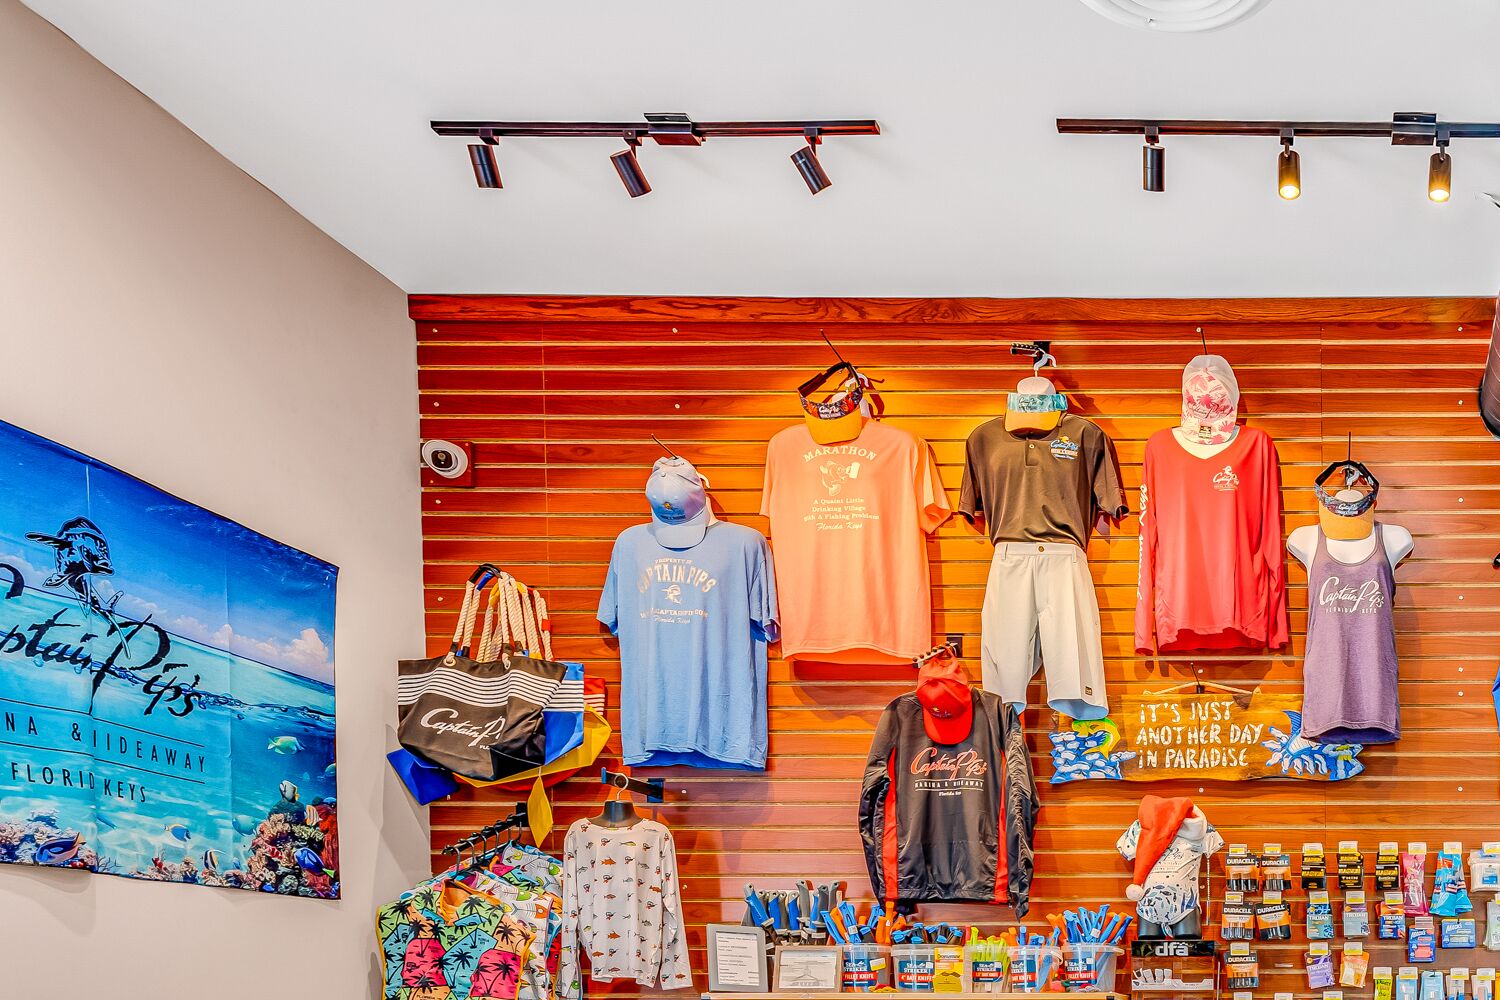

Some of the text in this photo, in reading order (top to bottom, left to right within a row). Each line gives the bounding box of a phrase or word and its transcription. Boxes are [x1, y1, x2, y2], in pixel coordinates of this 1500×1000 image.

[803, 445, 877, 463] MARATHON
[1319, 576, 1358, 607] Captain
[420, 707, 482, 739] Captain
[1188, 700, 1235, 721] JUST
[1135, 723, 1265, 746] ANOTHER DAY
[103, 774, 147, 803] KEYS
